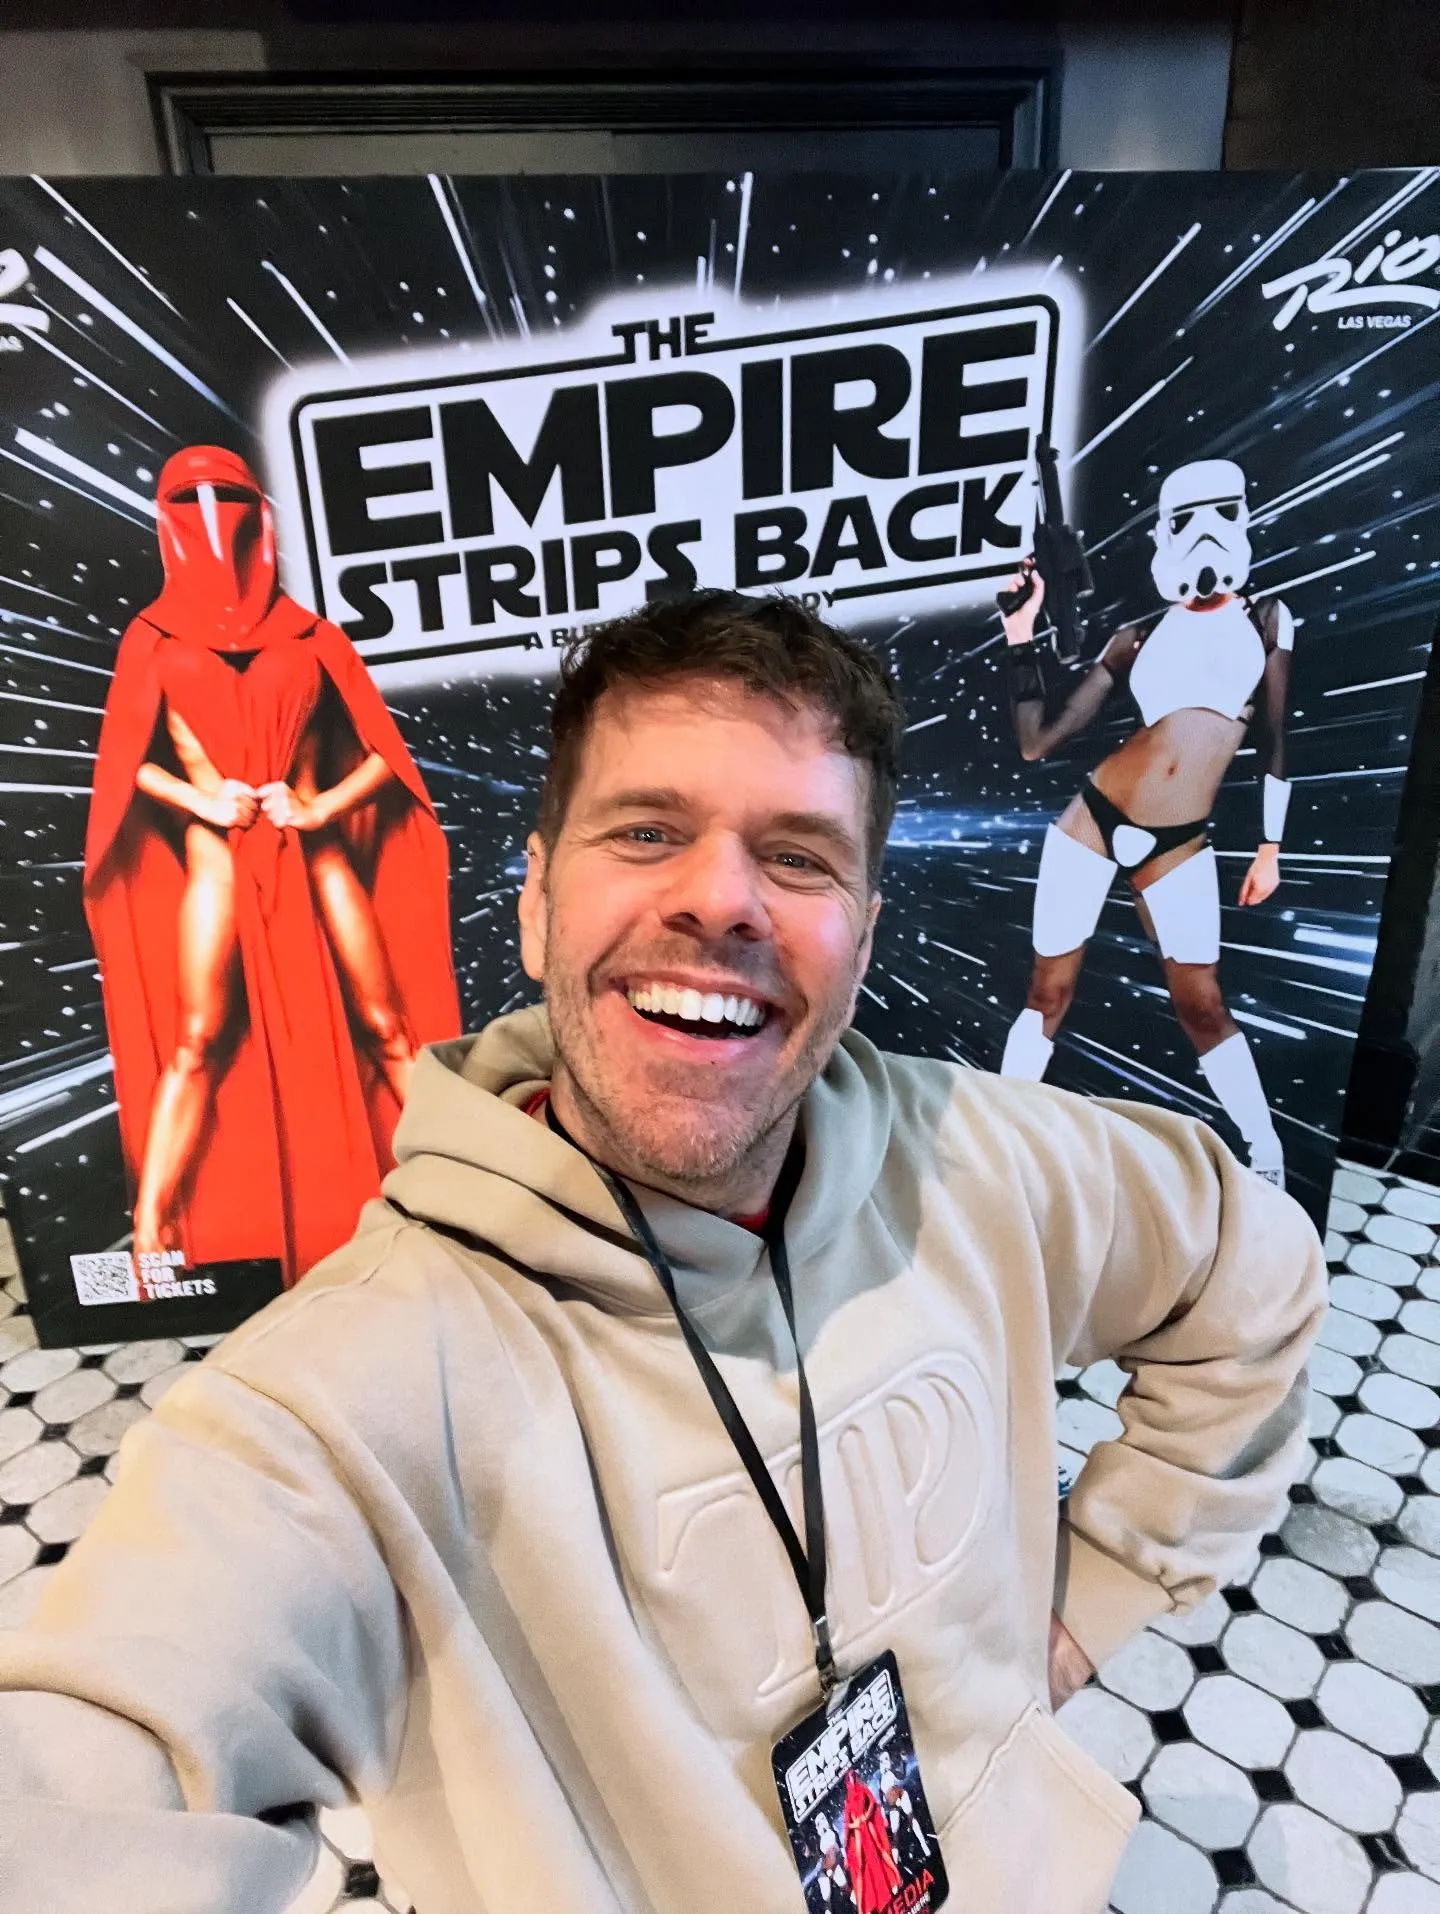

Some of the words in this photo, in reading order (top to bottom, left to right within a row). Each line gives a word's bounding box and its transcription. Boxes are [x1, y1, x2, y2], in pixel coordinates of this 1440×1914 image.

[1262, 230, 1440, 331] Rio
[611, 311, 715, 363] THE
[1337, 316, 1364, 329] LAS
[1367, 315, 1412, 329] VEGAS
[311, 320, 1038, 556] EMPIRE
[338, 519, 702, 642] STRIPS
[734, 471, 1023, 589] BACK
[523, 631, 544, 651] A
[140, 1266, 176, 1284] FOR
[144, 1279, 218, 1299] TICKETS
[788, 1672, 891, 1799] EMPIRE
[795, 1746, 850, 1815] STRIPS
